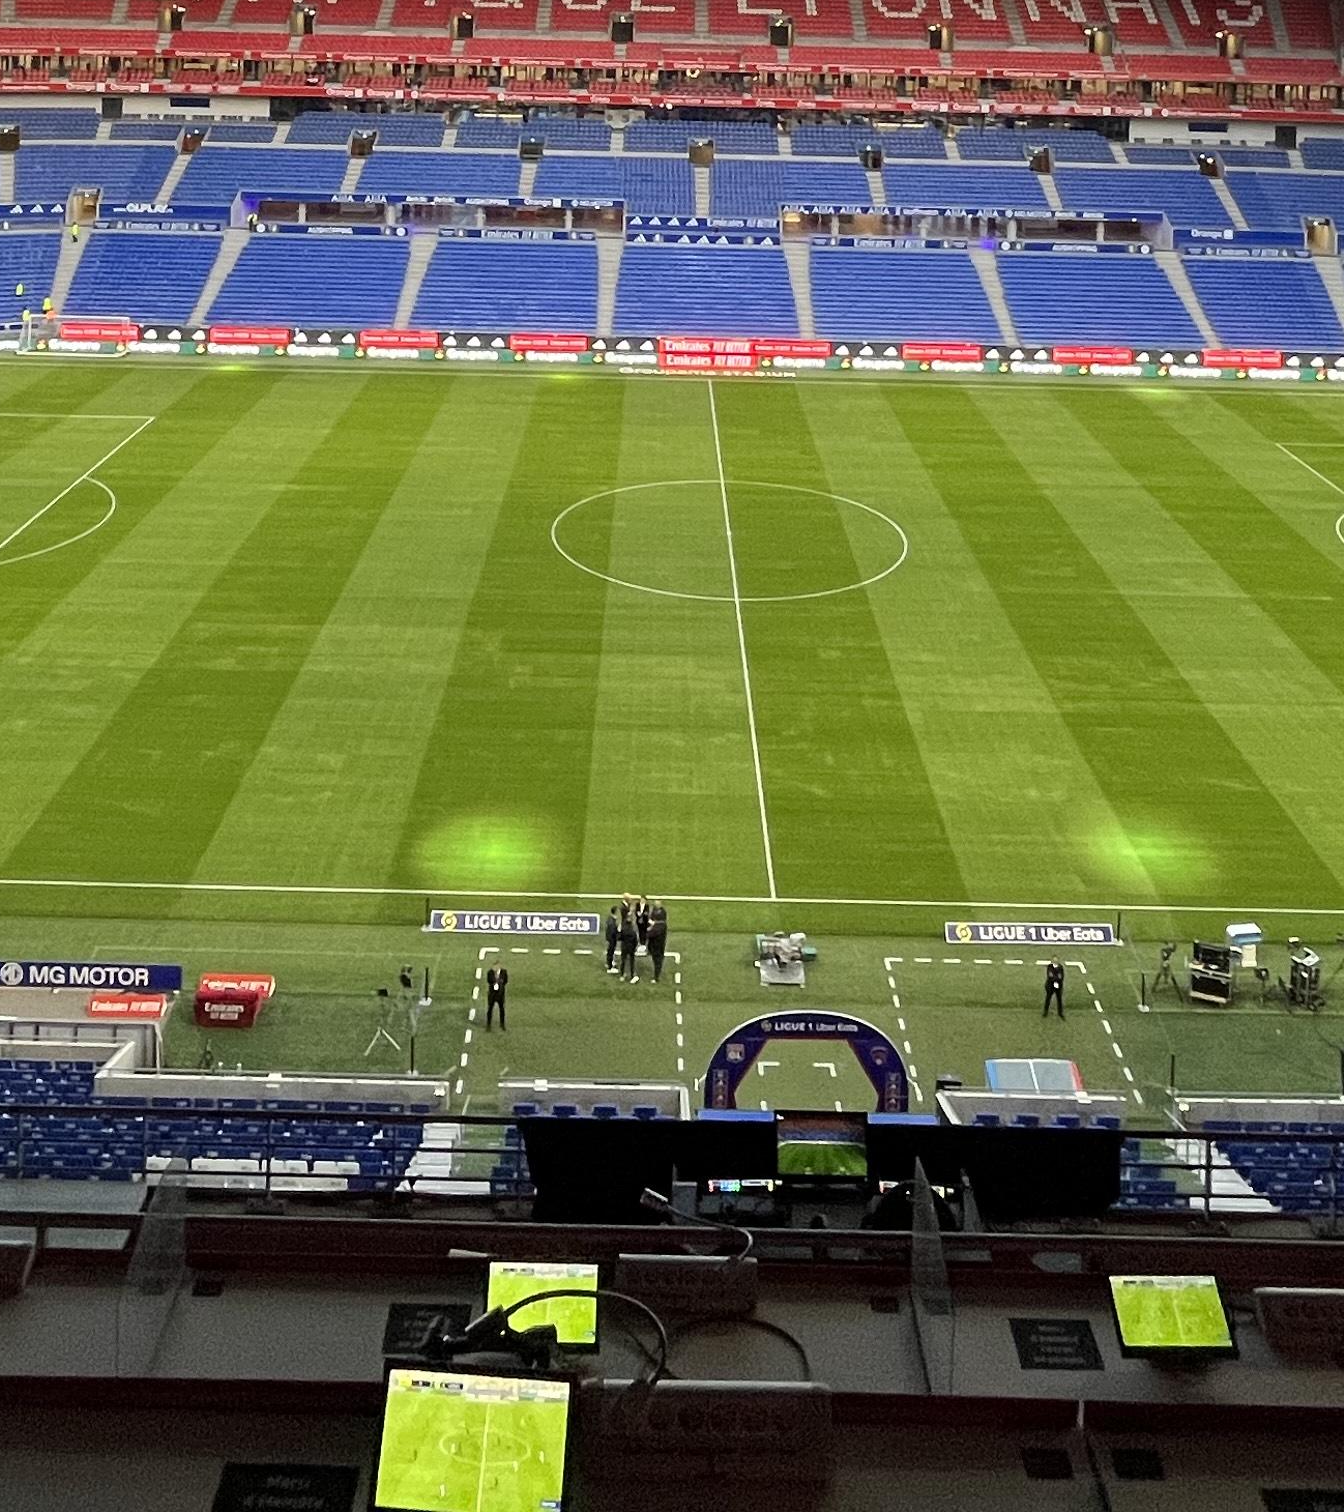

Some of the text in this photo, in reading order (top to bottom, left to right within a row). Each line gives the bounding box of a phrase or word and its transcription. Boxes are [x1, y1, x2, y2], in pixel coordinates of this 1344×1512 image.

[464, 914, 590, 931] LIGUE 1 Uber Eats
[979, 926, 1105, 941] LIGUE 1 Uber Eats
[29, 966, 149, 986] MG MOTOR
[774, 1022, 805, 1031] LIGUE
[808, 1022, 813, 1031] 1
[816, 1023, 836, 1032] Uber
